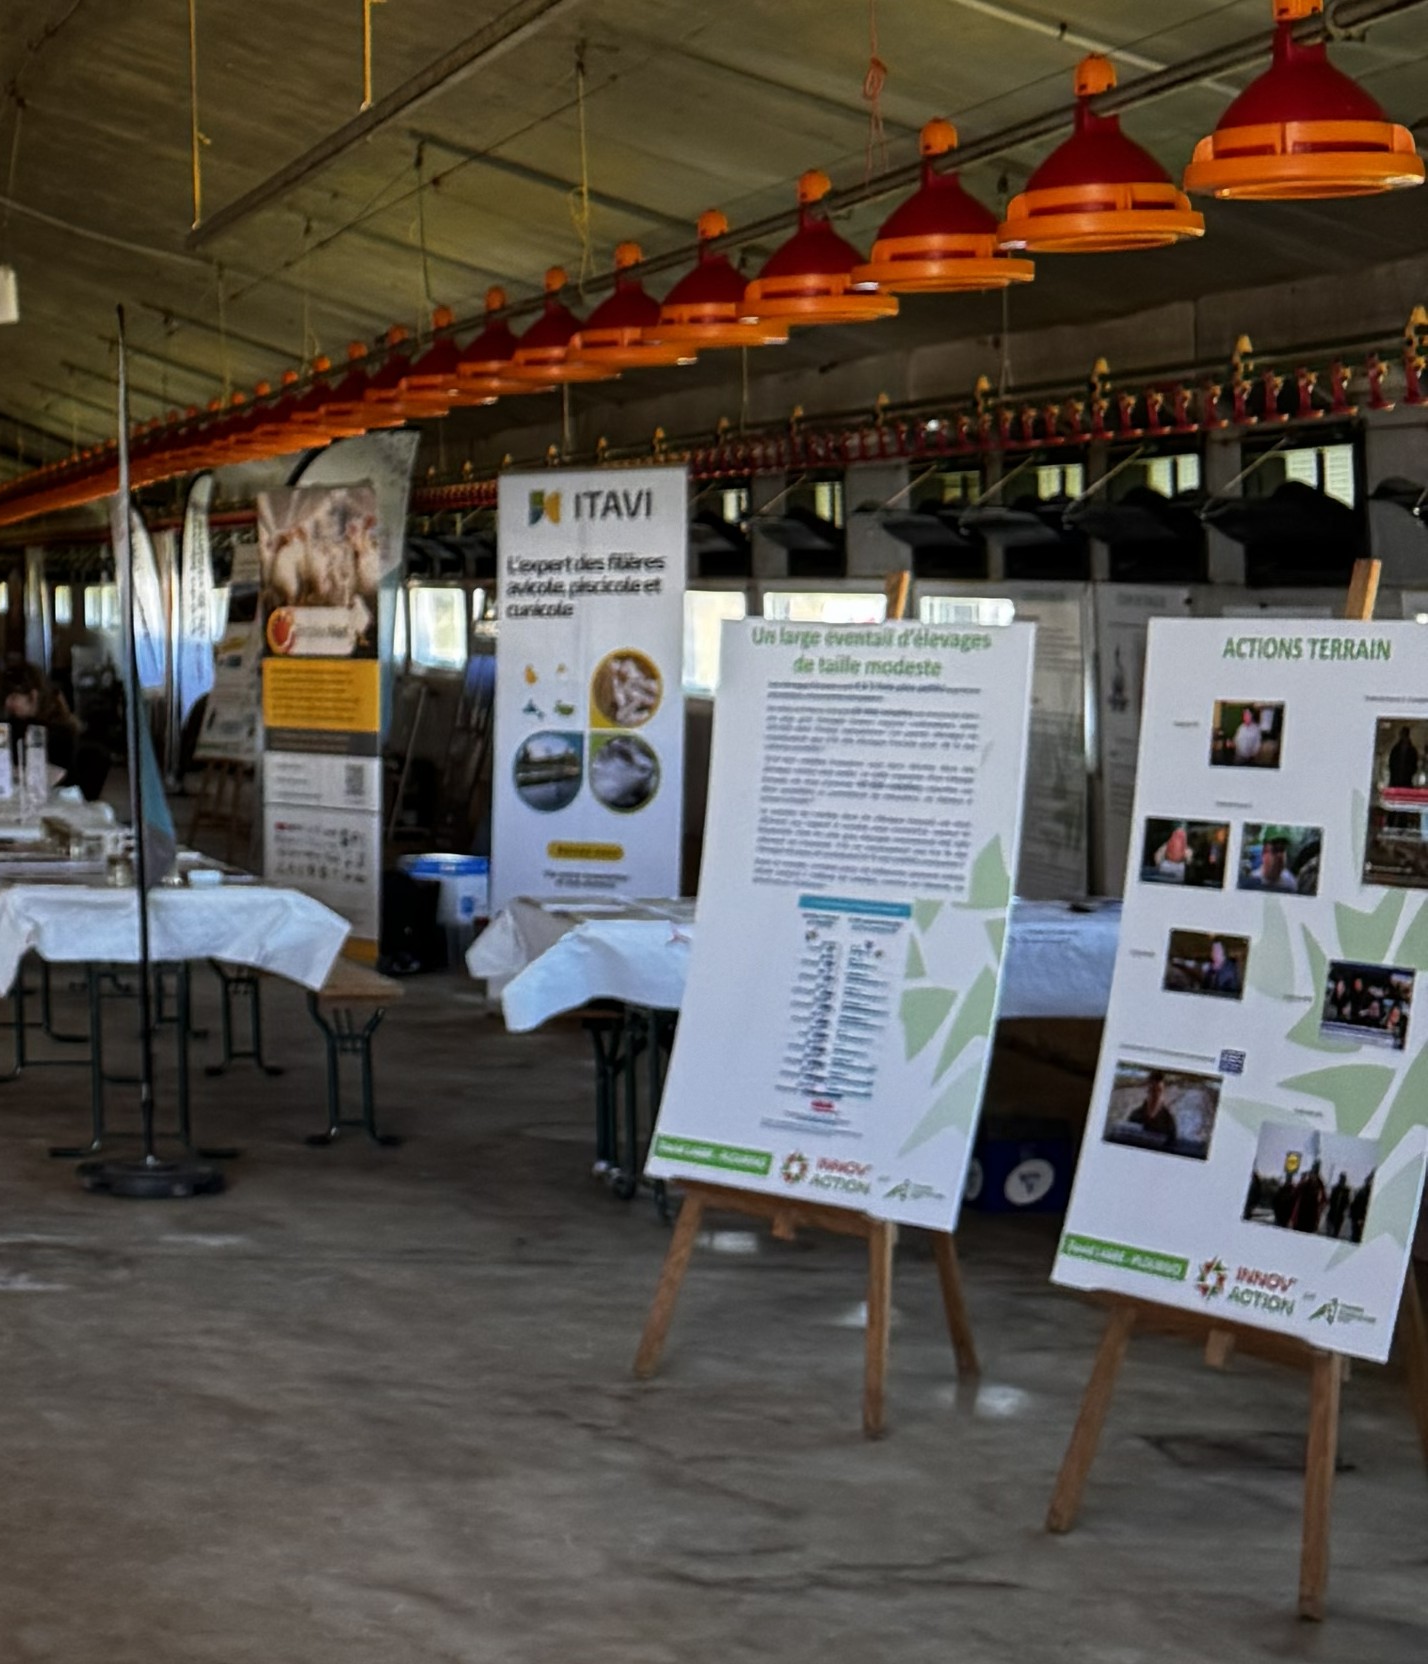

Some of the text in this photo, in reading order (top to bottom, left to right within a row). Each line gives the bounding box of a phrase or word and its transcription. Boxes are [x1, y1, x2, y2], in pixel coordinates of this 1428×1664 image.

[574, 489, 652, 520] ITAVI
[575, 554, 605, 571] des
[644, 578, 663, 594] et
[752, 627, 776, 646] Un
[779, 627, 822, 648] large
[824, 627, 893, 647] éventail
[1222, 637, 1392, 661] ACTIONS TERRAIN
[794, 654, 943, 677] de taille modeste
